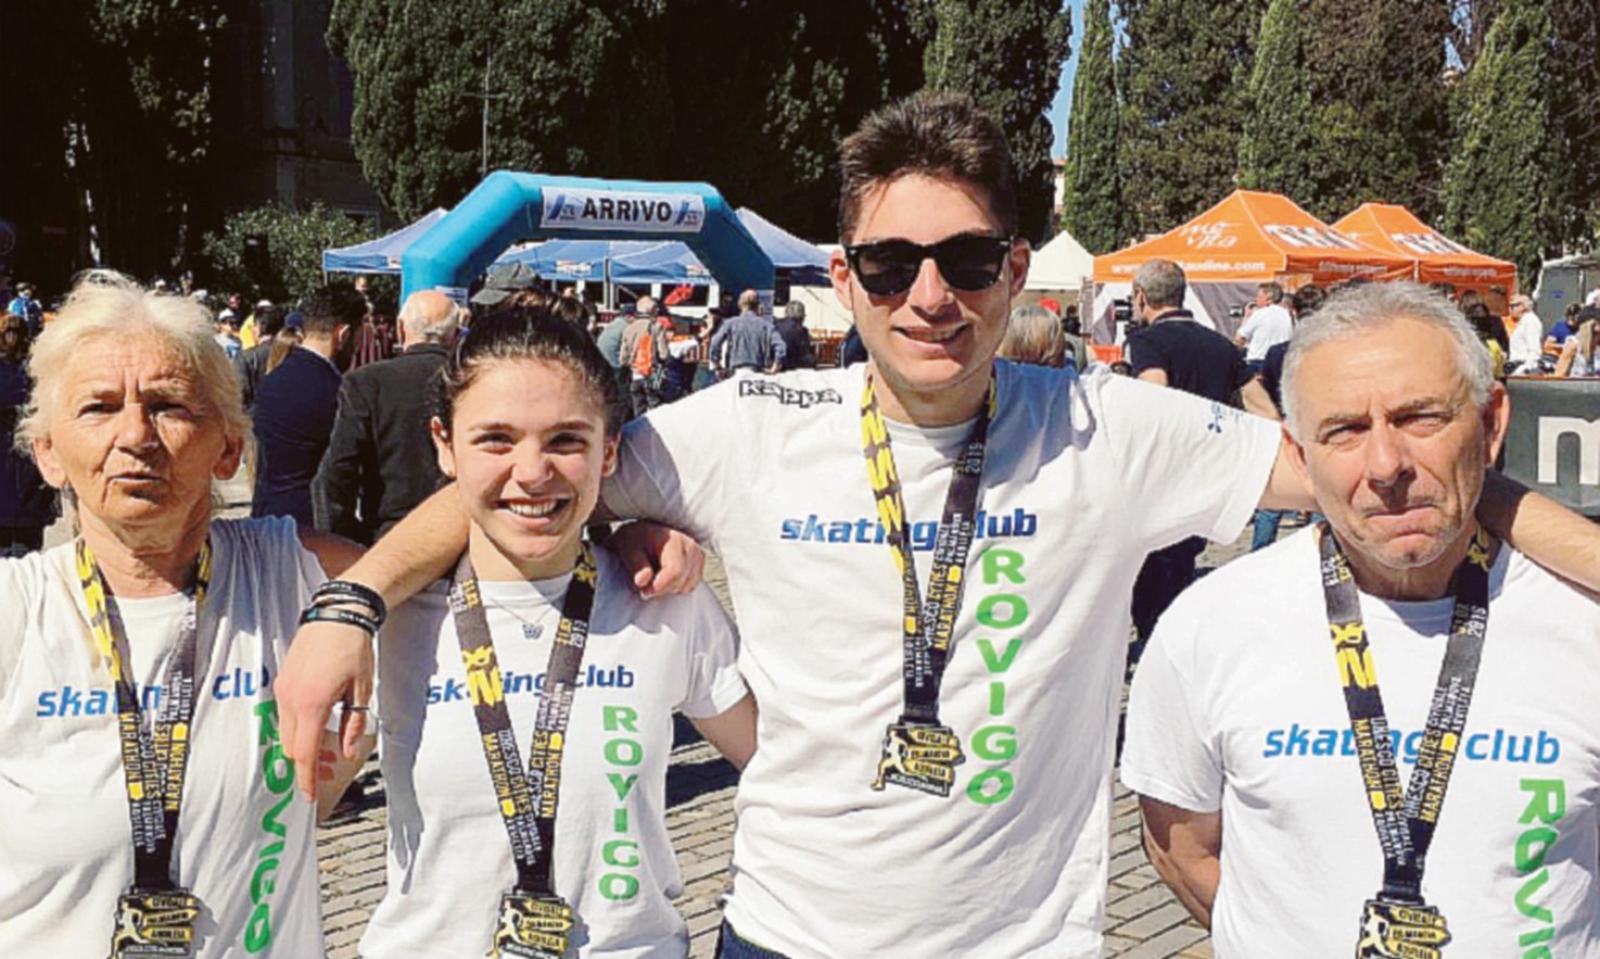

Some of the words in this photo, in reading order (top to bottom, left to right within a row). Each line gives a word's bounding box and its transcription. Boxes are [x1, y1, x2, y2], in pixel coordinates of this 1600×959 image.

[581, 197, 673, 222] ARRIVO
[1467, 606, 1488, 638] 2015
[966, 547, 1028, 805] ROVIGO
[119, 711, 143, 784] MARATHON
[483, 732, 511, 799] MARATHON
[1353, 718, 1383, 791] MARATHON
[1371, 716, 1397, 767] UNESCO
[1465, 729, 1560, 764] club
[165, 742, 187, 811] MARATHON
[541, 750, 561, 819] MARATHON
[598, 706, 644, 902] ROVIGO
[1405, 768, 1431, 818] UNESCO
[1419, 751, 1456, 823] MARATHON
[244, 700, 296, 954] ROVIGO
